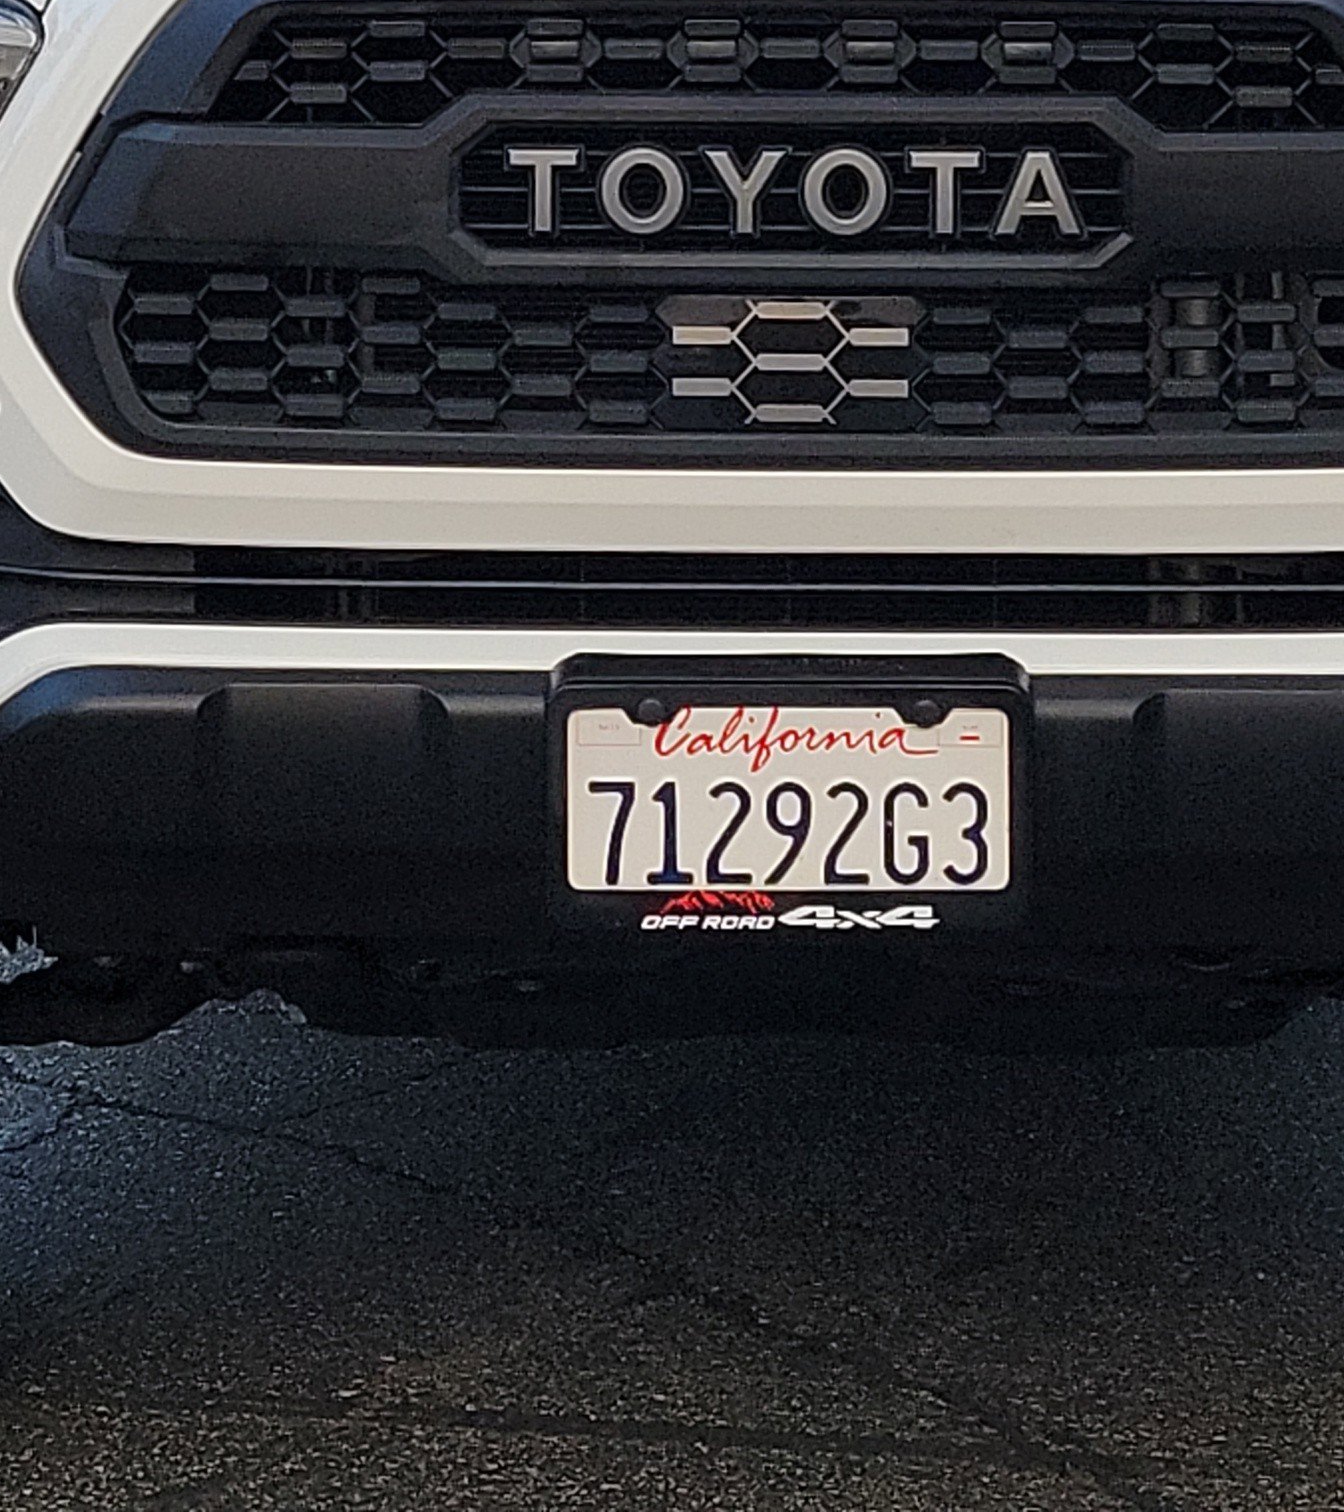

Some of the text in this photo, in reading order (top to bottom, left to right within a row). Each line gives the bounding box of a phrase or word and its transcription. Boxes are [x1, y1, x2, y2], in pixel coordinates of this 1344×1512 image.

[508, 147, 1082, 236] TOYOTA
[654, 705, 939, 773] California
[588, 781, 989, 886] 71292G3
[640, 914, 700, 930] OFF
[701, 914, 775, 930] ROAD
